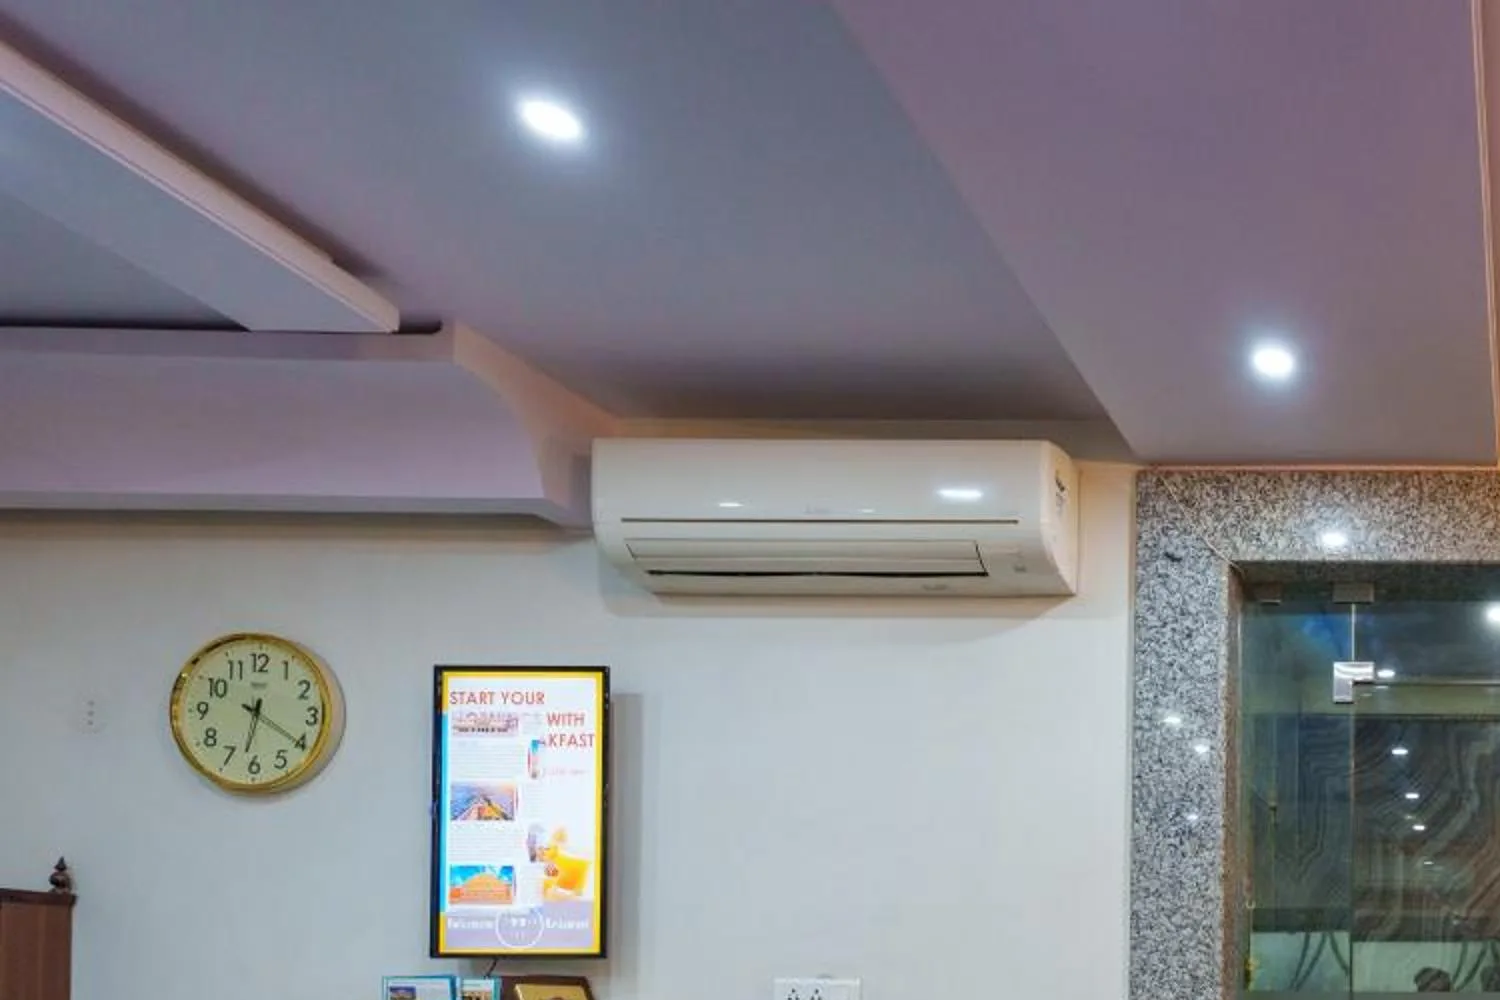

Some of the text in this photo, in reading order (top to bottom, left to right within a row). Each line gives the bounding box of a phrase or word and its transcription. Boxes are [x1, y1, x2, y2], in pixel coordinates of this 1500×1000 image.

[228, 660, 244, 680] 11
[250, 653, 270, 673] 12
[281, 660, 289, 680] 1
[208, 678, 228, 698] 10
[297, 680, 311, 700] 2
[449, 691, 545, 705] START YOUR
[196, 702, 209, 721] 9
[305, 706, 318, 726] 3
[547, 712, 585, 726] WITH
[204, 728, 217, 747] 8
[294, 733, 307, 751] 4
[223, 745, 236, 766] 7
[247, 755, 261, 775] 6
[273, 750, 288, 769] 5
